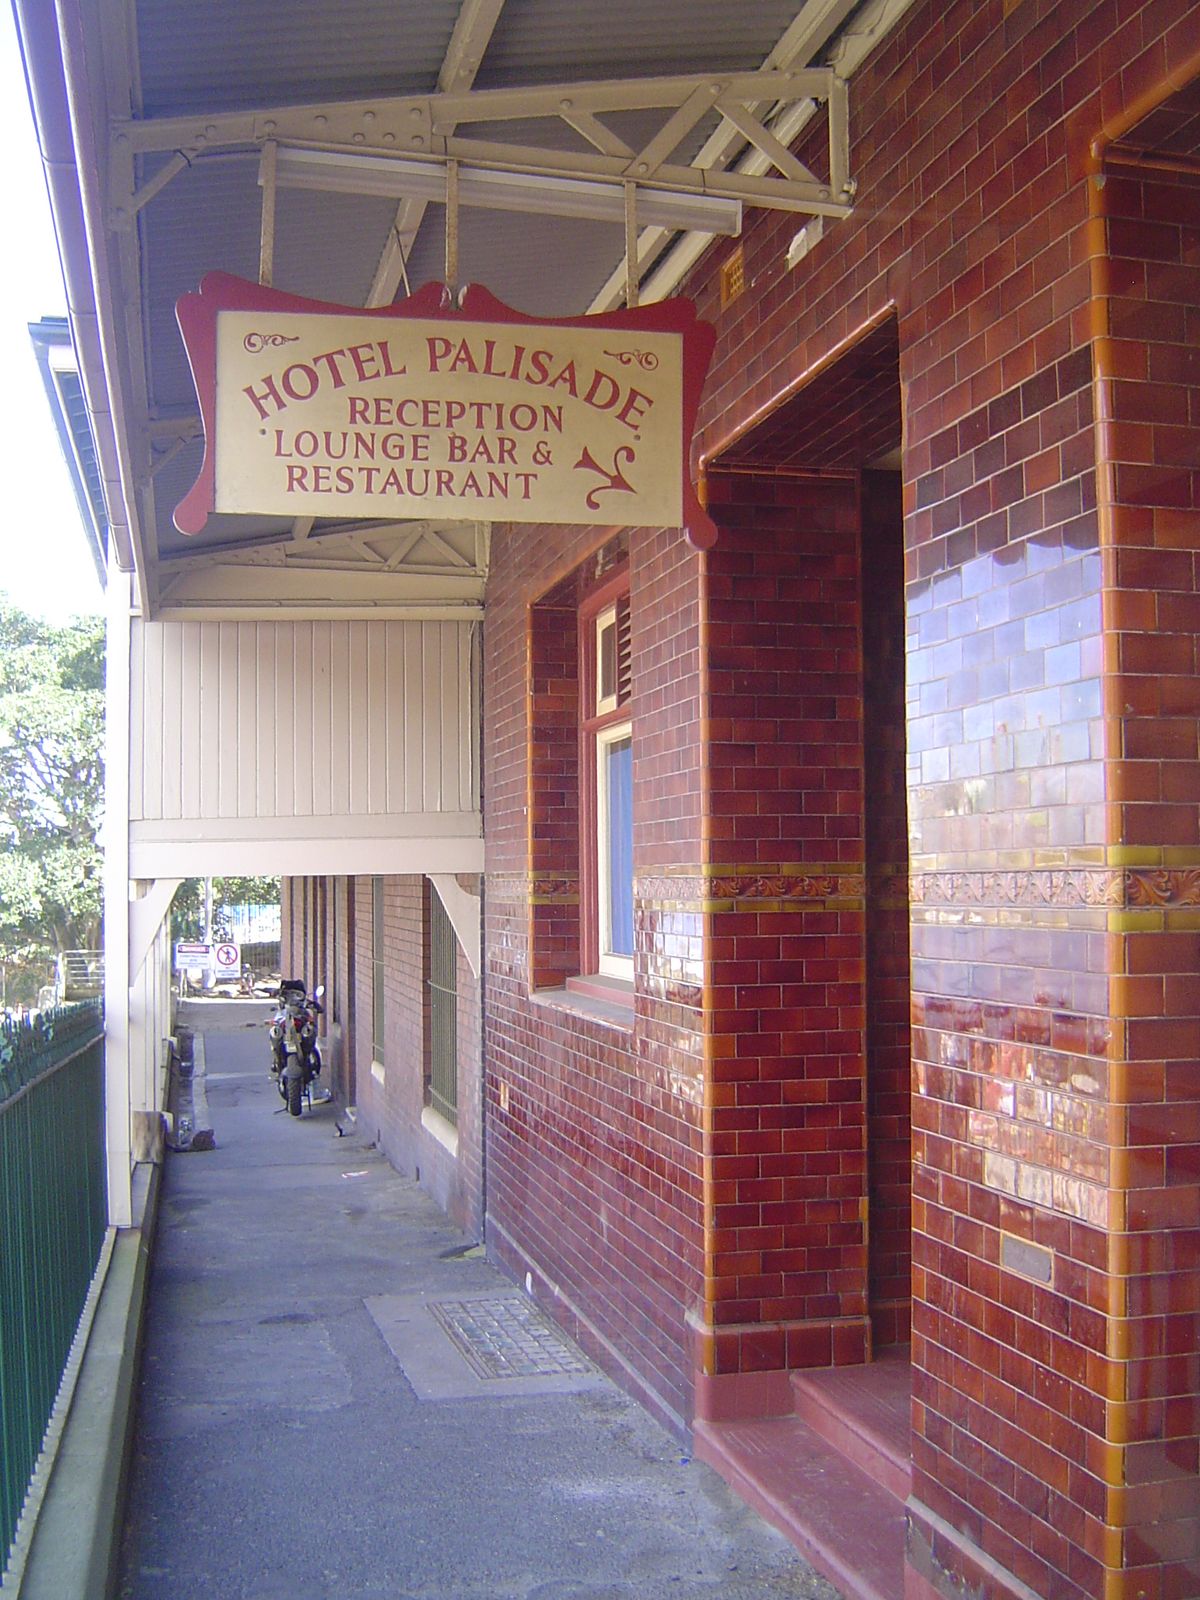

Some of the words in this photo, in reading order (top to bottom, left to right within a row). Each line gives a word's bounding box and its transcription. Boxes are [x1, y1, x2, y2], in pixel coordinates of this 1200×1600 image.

[243, 341, 406, 421] HOTEL
[425, 337, 654, 432] PALISADE
[347, 396, 563, 434] RECEPTION
[274, 429, 430, 462] LOUNGE
[448, 433, 518, 466] BAR
[532, 441, 554, 466] &
[286, 465, 538, 500] RESTAURANT
